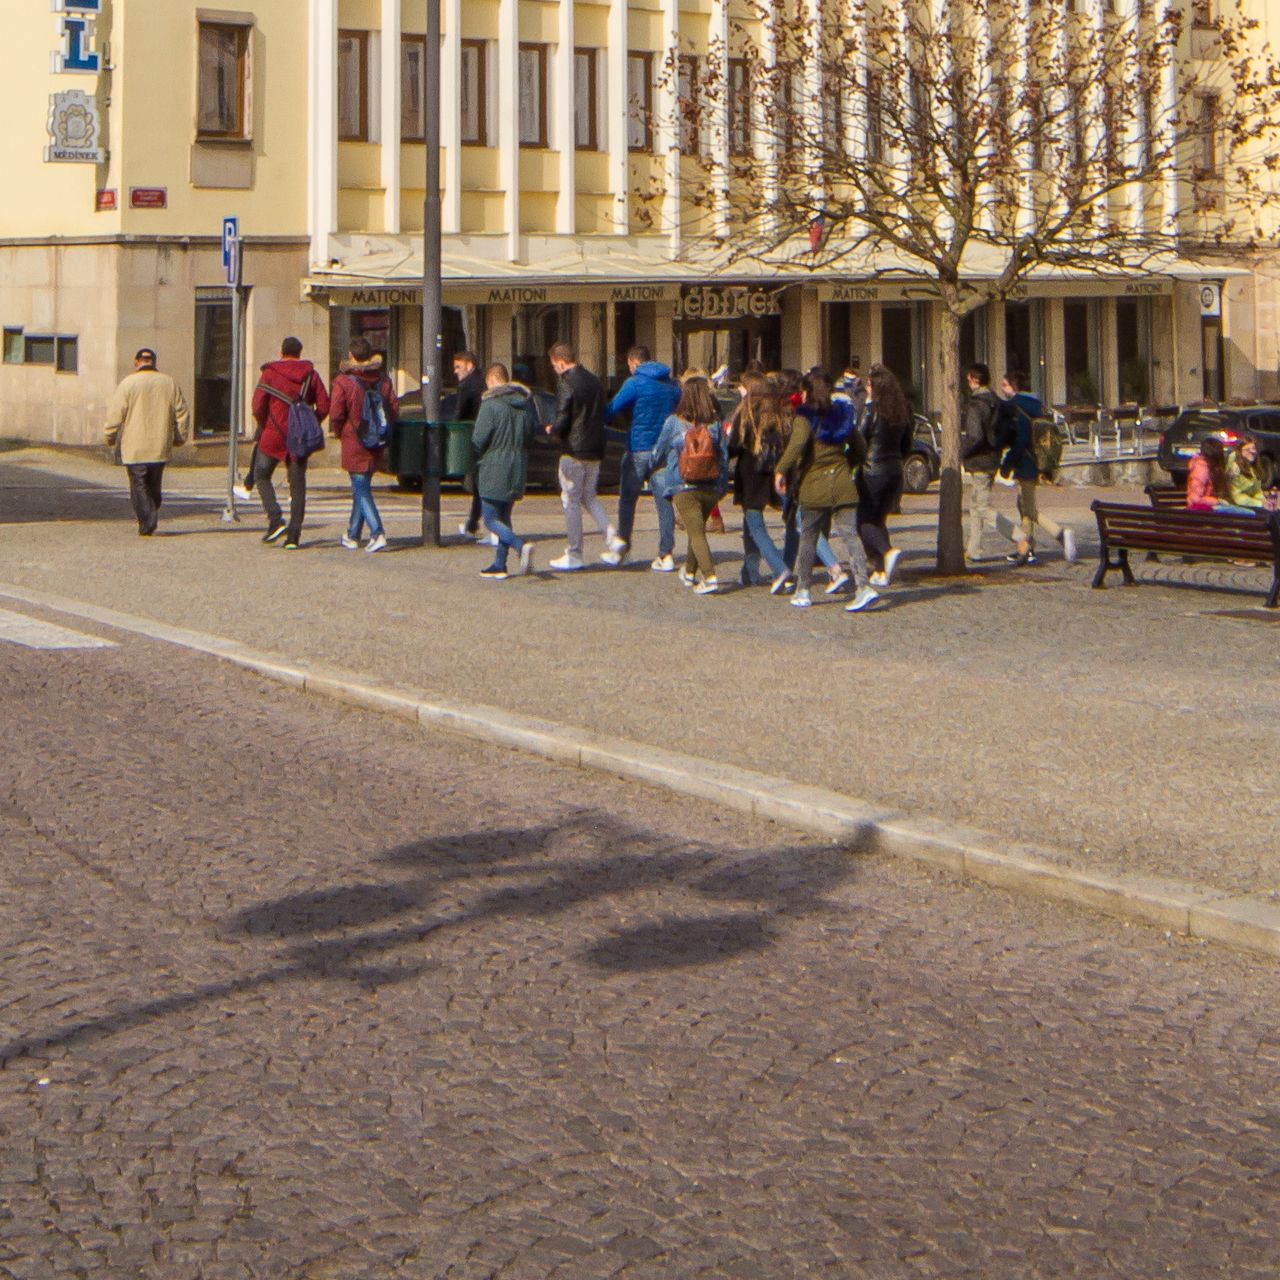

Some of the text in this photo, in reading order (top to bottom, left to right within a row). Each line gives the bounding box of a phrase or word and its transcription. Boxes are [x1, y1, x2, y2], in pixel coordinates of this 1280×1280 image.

[351, 289, 416, 304] MATTONI
[488, 288, 547, 303] MATTONI
[611, 286, 665, 300] MATTONI
[832, 287, 879, 300] MATTONI
